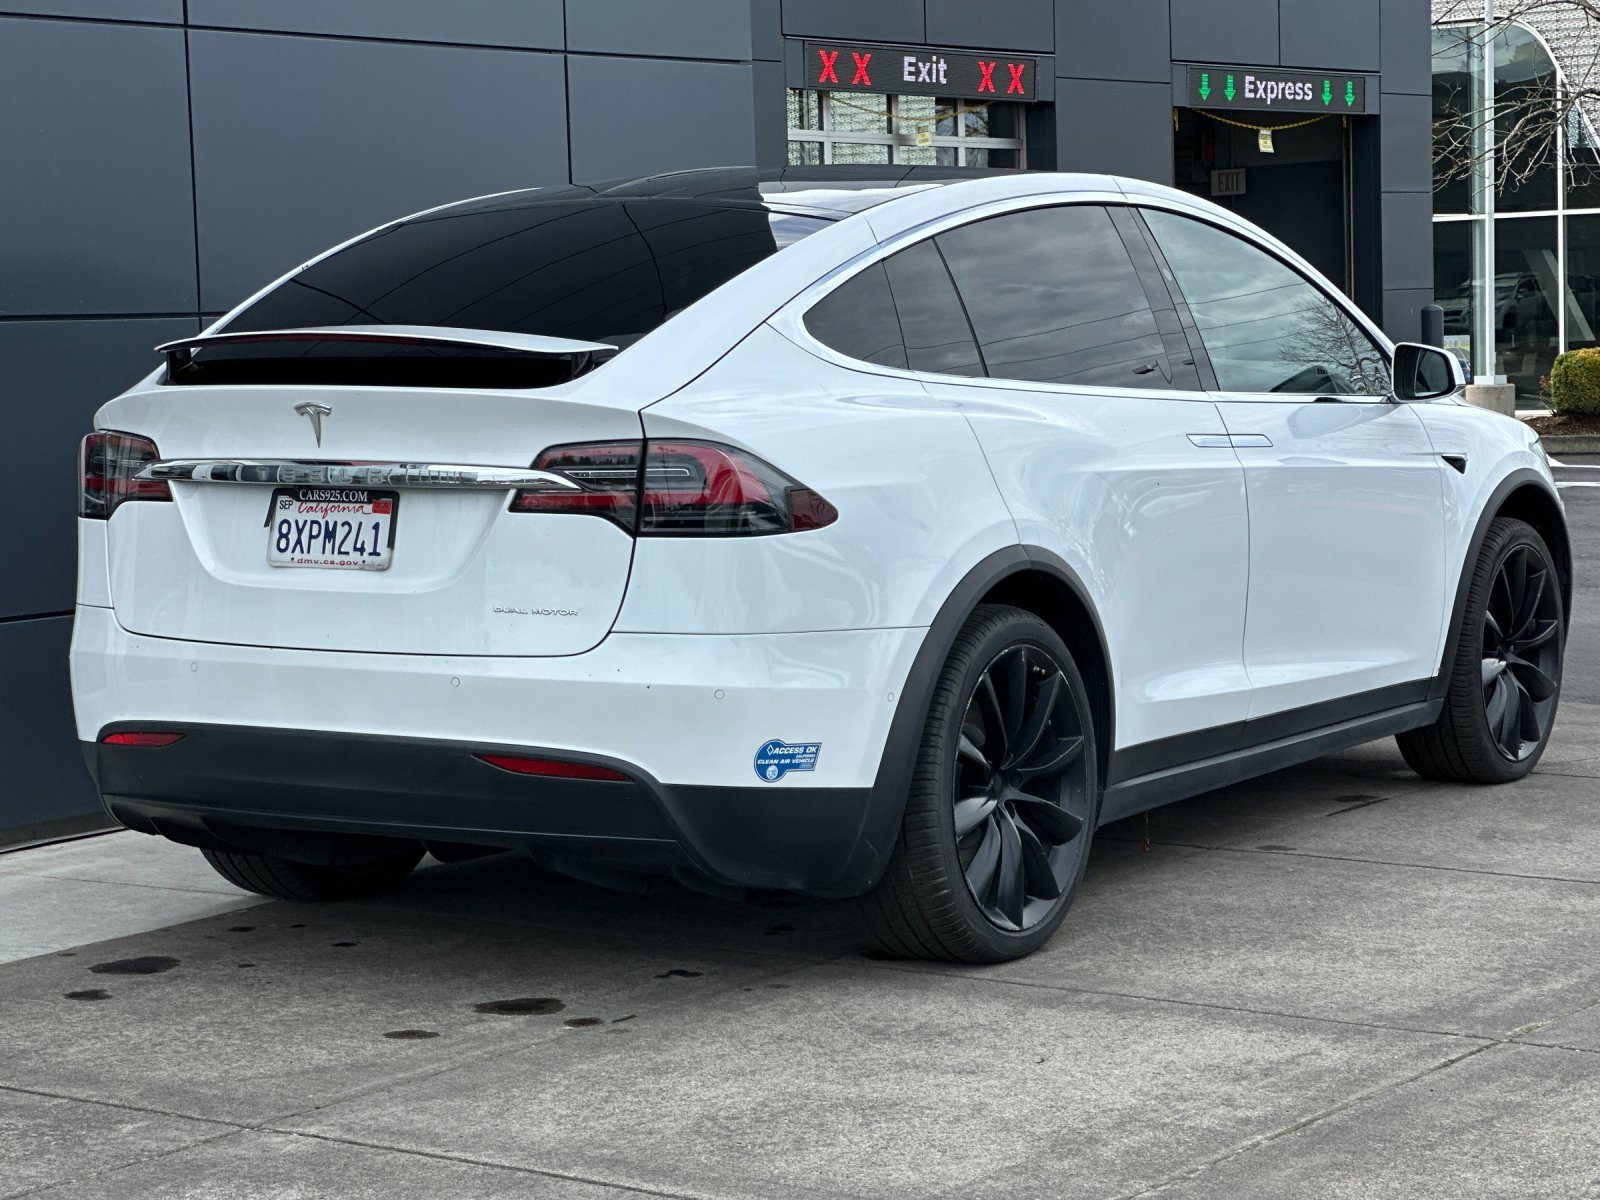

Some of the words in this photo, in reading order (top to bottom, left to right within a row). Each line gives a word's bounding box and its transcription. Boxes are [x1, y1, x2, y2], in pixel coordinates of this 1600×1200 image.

[903, 55, 948, 85] Exit
[1244, 75, 1313, 105] Express
[1217, 171, 1241, 193] EXIT
[299, 489, 368, 502] CARS925.COM
[279, 500, 293, 510] SEP
[298, 501, 372, 519] California
[276, 518, 382, 557] 8XPM241
[297, 558, 358, 566] dmv.ca.gov
[494, 606, 528, 614] DUAL
[532, 608, 578, 616] MOTOR
